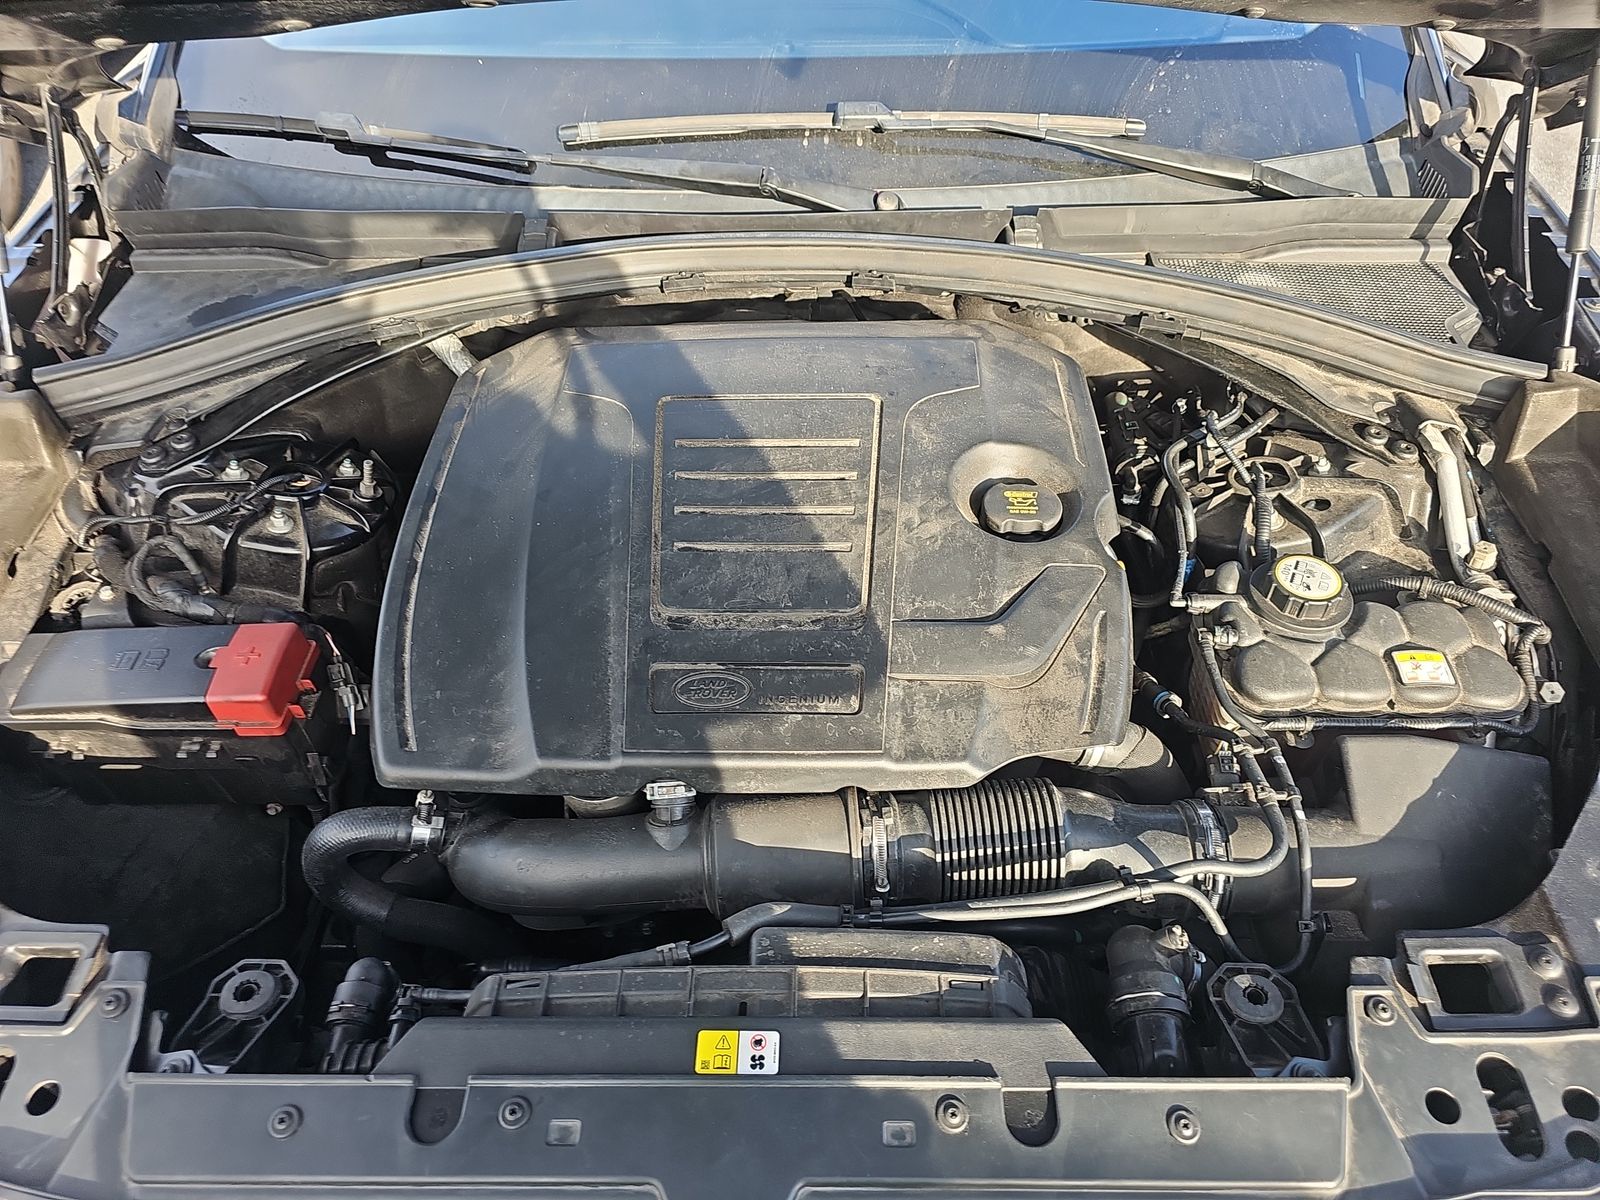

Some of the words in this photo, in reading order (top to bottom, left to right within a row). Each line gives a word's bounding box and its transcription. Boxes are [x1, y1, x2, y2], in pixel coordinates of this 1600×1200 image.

[689, 679, 728, 689] LAND
[688, 689, 738, 700] ROVER
[758, 694, 841, 706] INGENIUM
